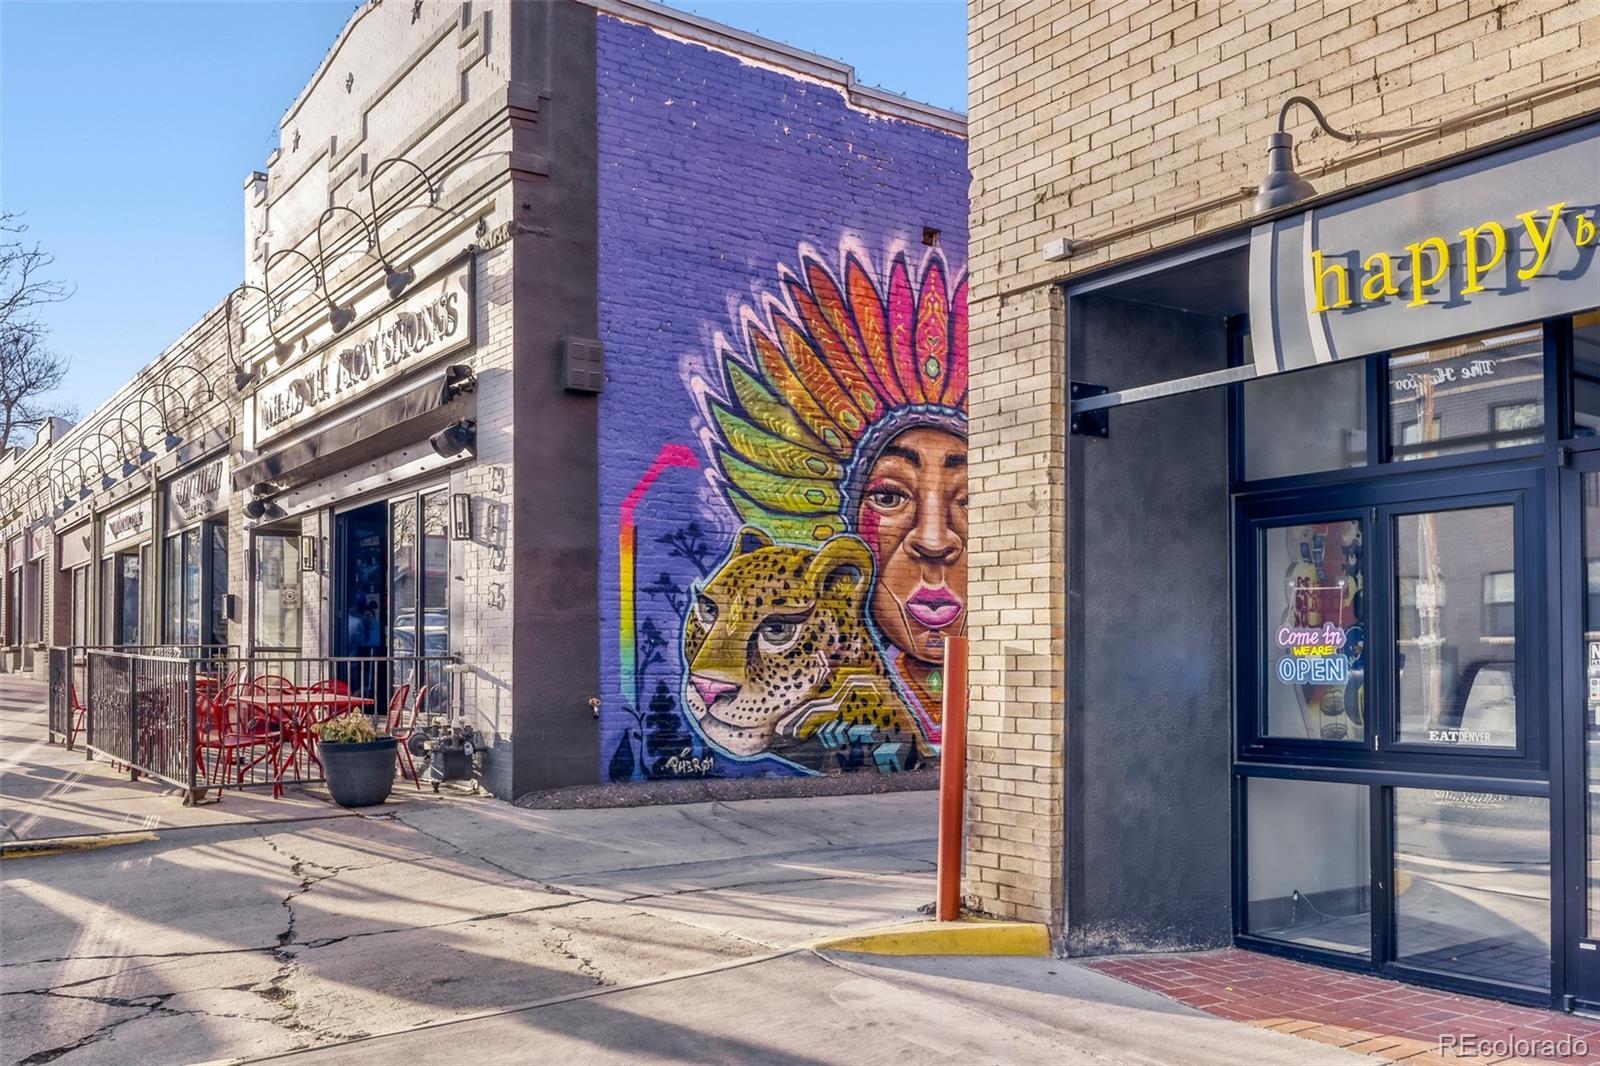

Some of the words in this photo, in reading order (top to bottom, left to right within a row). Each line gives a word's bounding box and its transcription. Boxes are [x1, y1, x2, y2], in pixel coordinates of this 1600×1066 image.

[1311, 202, 1567, 314] happy
[1278, 627, 1319, 646] Come
[1322, 625, 1342, 645] in
[1279, 657, 1345, 682] OPEN
